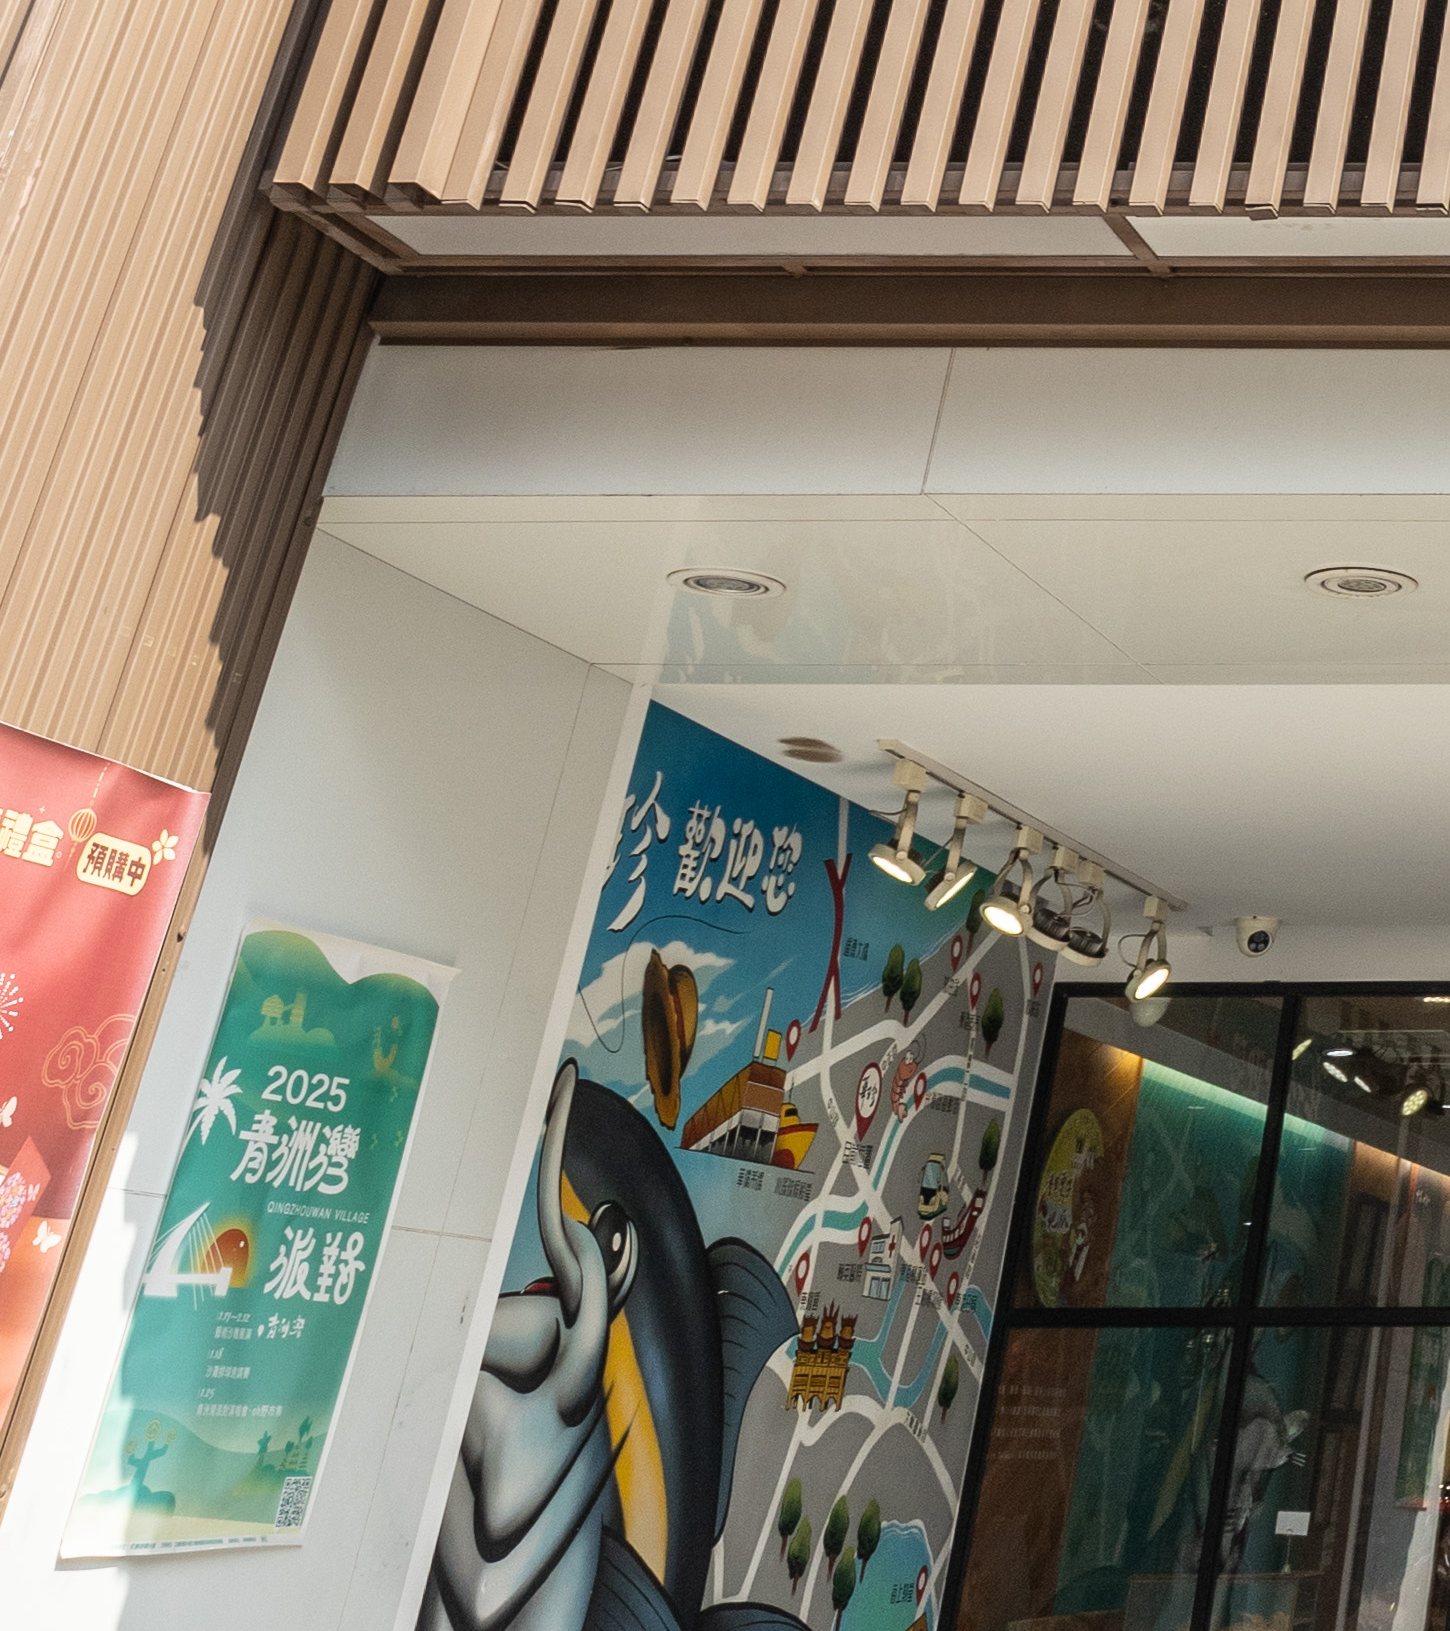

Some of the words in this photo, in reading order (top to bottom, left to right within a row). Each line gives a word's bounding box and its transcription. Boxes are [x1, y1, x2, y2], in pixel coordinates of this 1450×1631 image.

[0, 808, 64, 867] 禮盒
[83, 842, 146, 887] 預購中
[261, 1065, 350, 1113] 2025
[230, 1109, 361, 1195] 青洲灣
[267, 1201, 331, 1220] QINGZHOUWAN
[333, 1210, 370, 1225] VILLAGE
